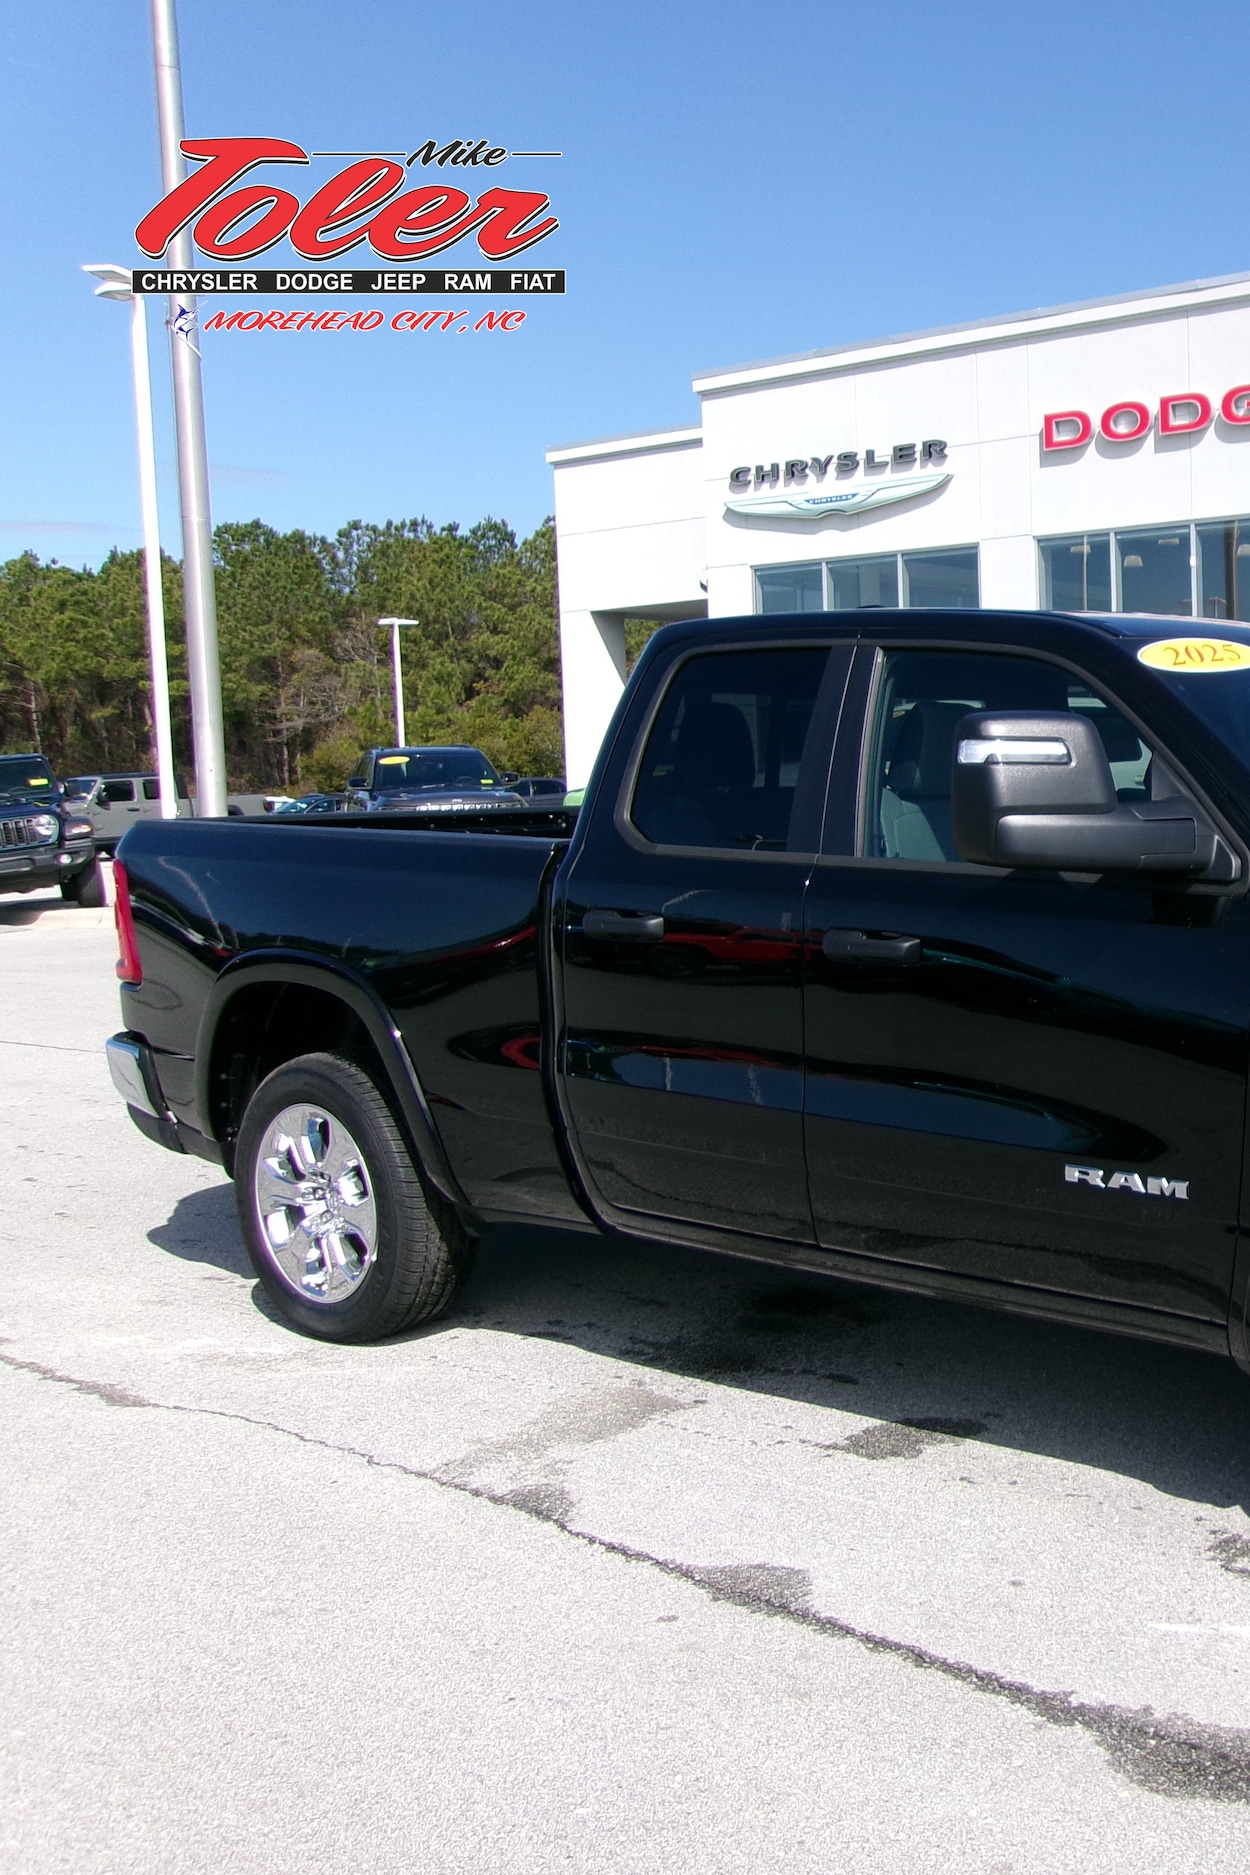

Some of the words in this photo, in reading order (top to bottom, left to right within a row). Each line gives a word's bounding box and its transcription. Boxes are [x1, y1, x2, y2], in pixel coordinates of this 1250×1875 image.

[729, 438, 949, 486] CHRYSLER
[1163, 644, 1241, 666] 2025
[1064, 1163, 1190, 1200] RAM
